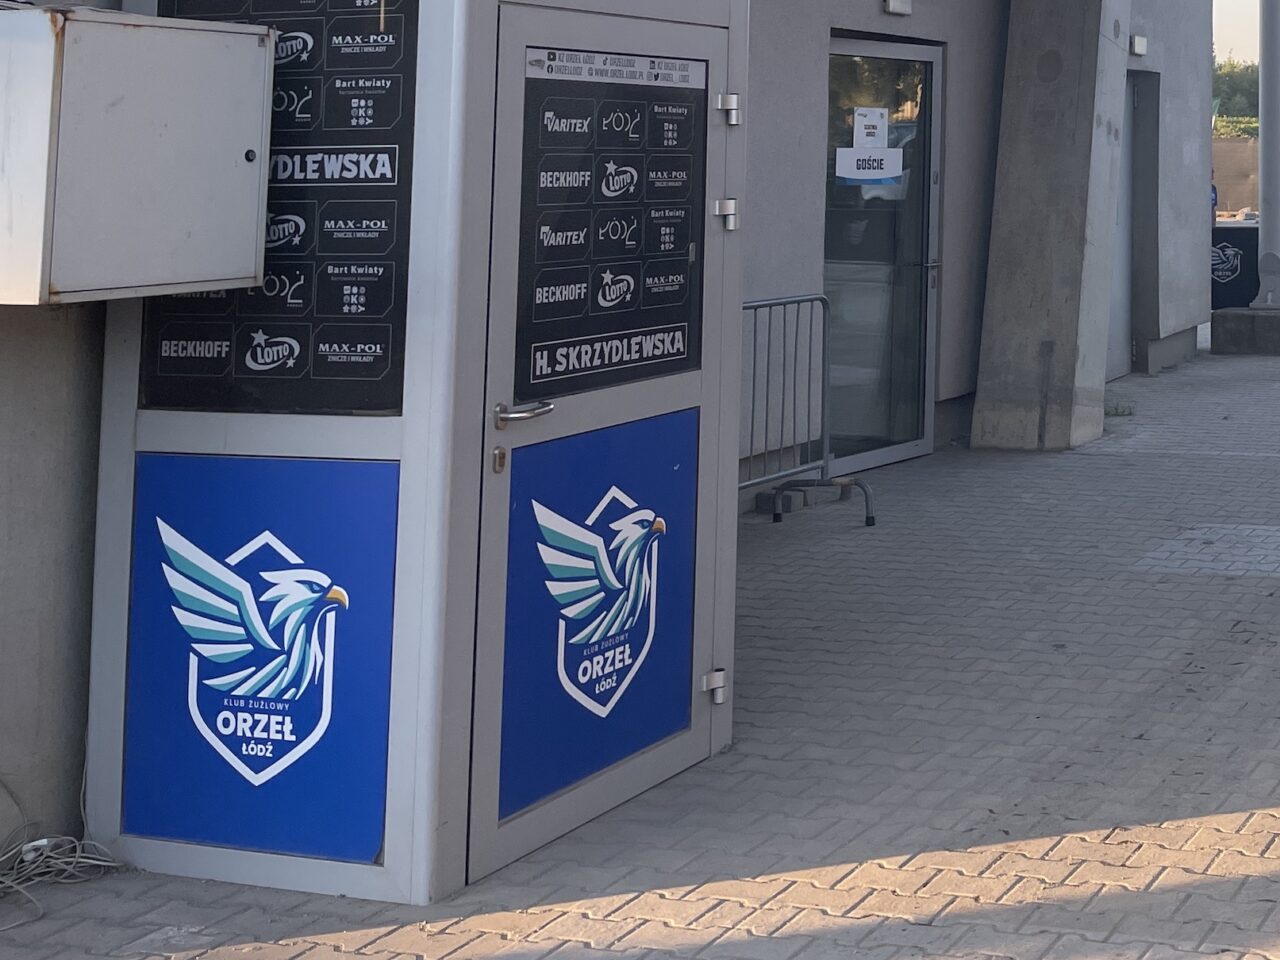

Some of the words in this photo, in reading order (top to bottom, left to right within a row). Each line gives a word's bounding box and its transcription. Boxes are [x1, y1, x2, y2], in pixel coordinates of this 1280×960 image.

[276, 38, 304, 58] OTTO
[331, 34, 396, 44] MAX-POL
[335, 79, 356, 88] Bart
[358, 78, 391, 88] Kwiaty
[545, 113, 592, 133] VARITEX
[856, 155, 885, 170] GOŚCIE
[540, 171, 591, 188] BECKHOFF
[609, 172, 632, 191] LOTTO
[648, 171, 688, 179] MAX-POL
[324, 220, 389, 229] MAX-POL
[542, 227, 588, 247] VARITEX
[327, 265, 348, 274] Bart
[350, 265, 384, 276] Kwiaty
[646, 274, 684, 285] MAX-POL
[535, 283, 587, 304] BECKHOFF
[605, 280, 629, 301] LOTTO
[161, 340, 230, 357] BECKHOFF
[256, 343, 289, 364] LOTTO
[318, 343, 384, 353] MAX-POL
[535, 350, 551, 376] H.
[555, 330, 684, 372] SKRZYDLEWSKA
[578, 643, 632, 684] ORZEŁ
[595, 671, 617, 694] ŁÓDŹ
[223, 698, 245, 707] KLUB
[216, 710, 297, 742] ORZEŁ
[241, 740, 274, 758] ŁÓDŹ
